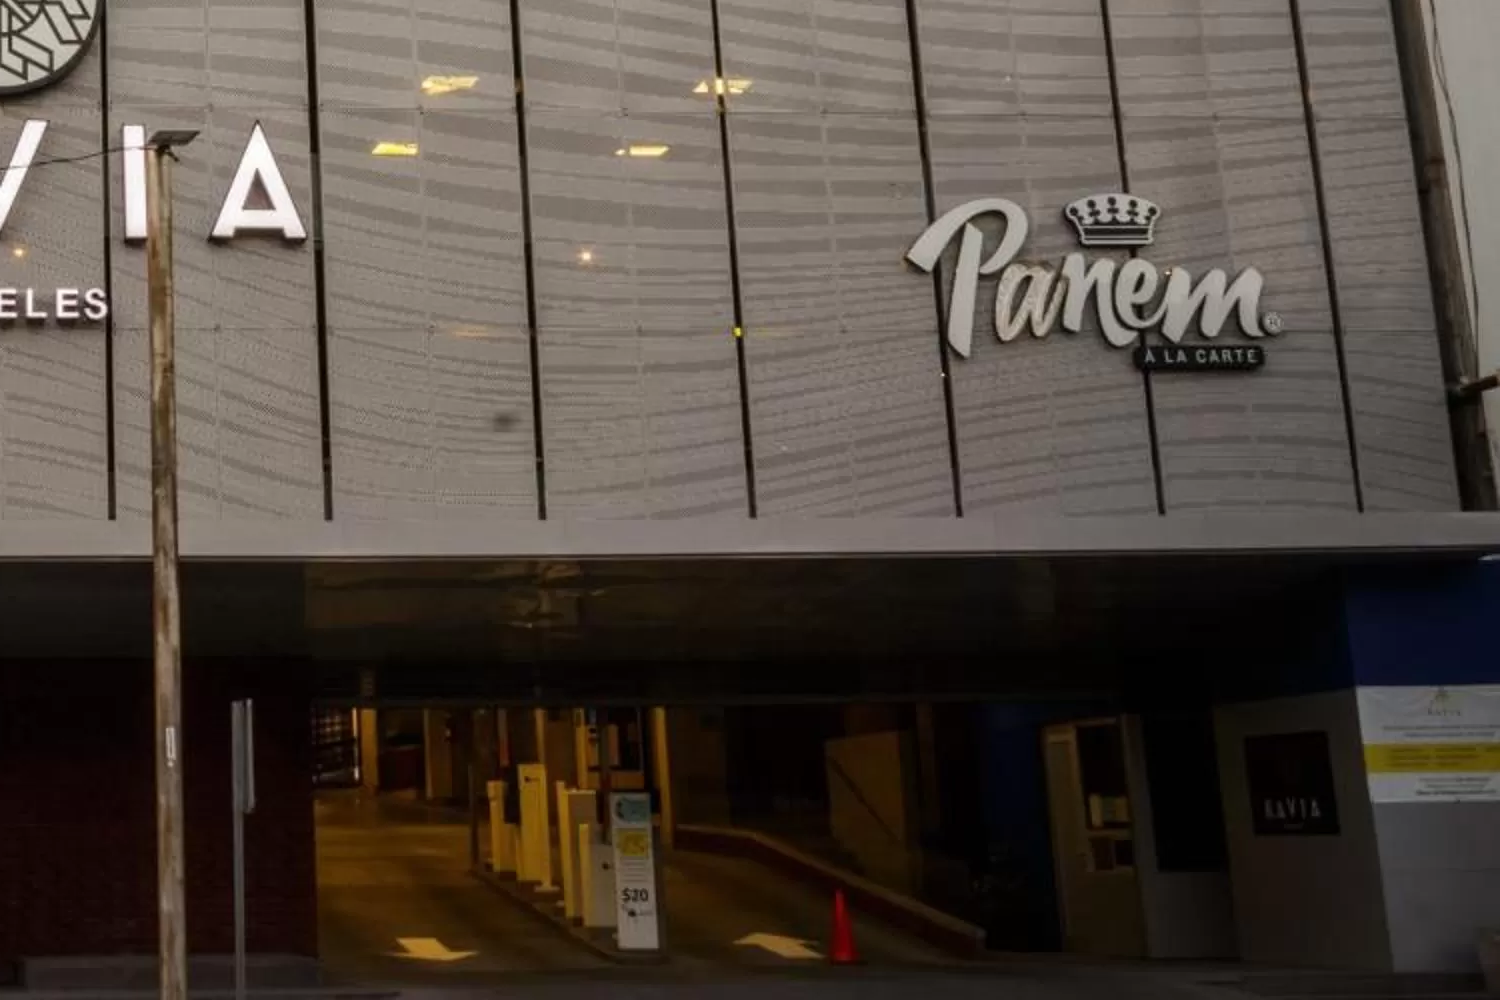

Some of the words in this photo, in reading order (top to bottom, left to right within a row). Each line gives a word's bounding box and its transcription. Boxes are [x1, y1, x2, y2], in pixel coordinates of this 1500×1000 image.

[905, 198, 1266, 359] Panem
[1163, 348, 1188, 364] LA
[1195, 348, 1259, 365] CARTE
